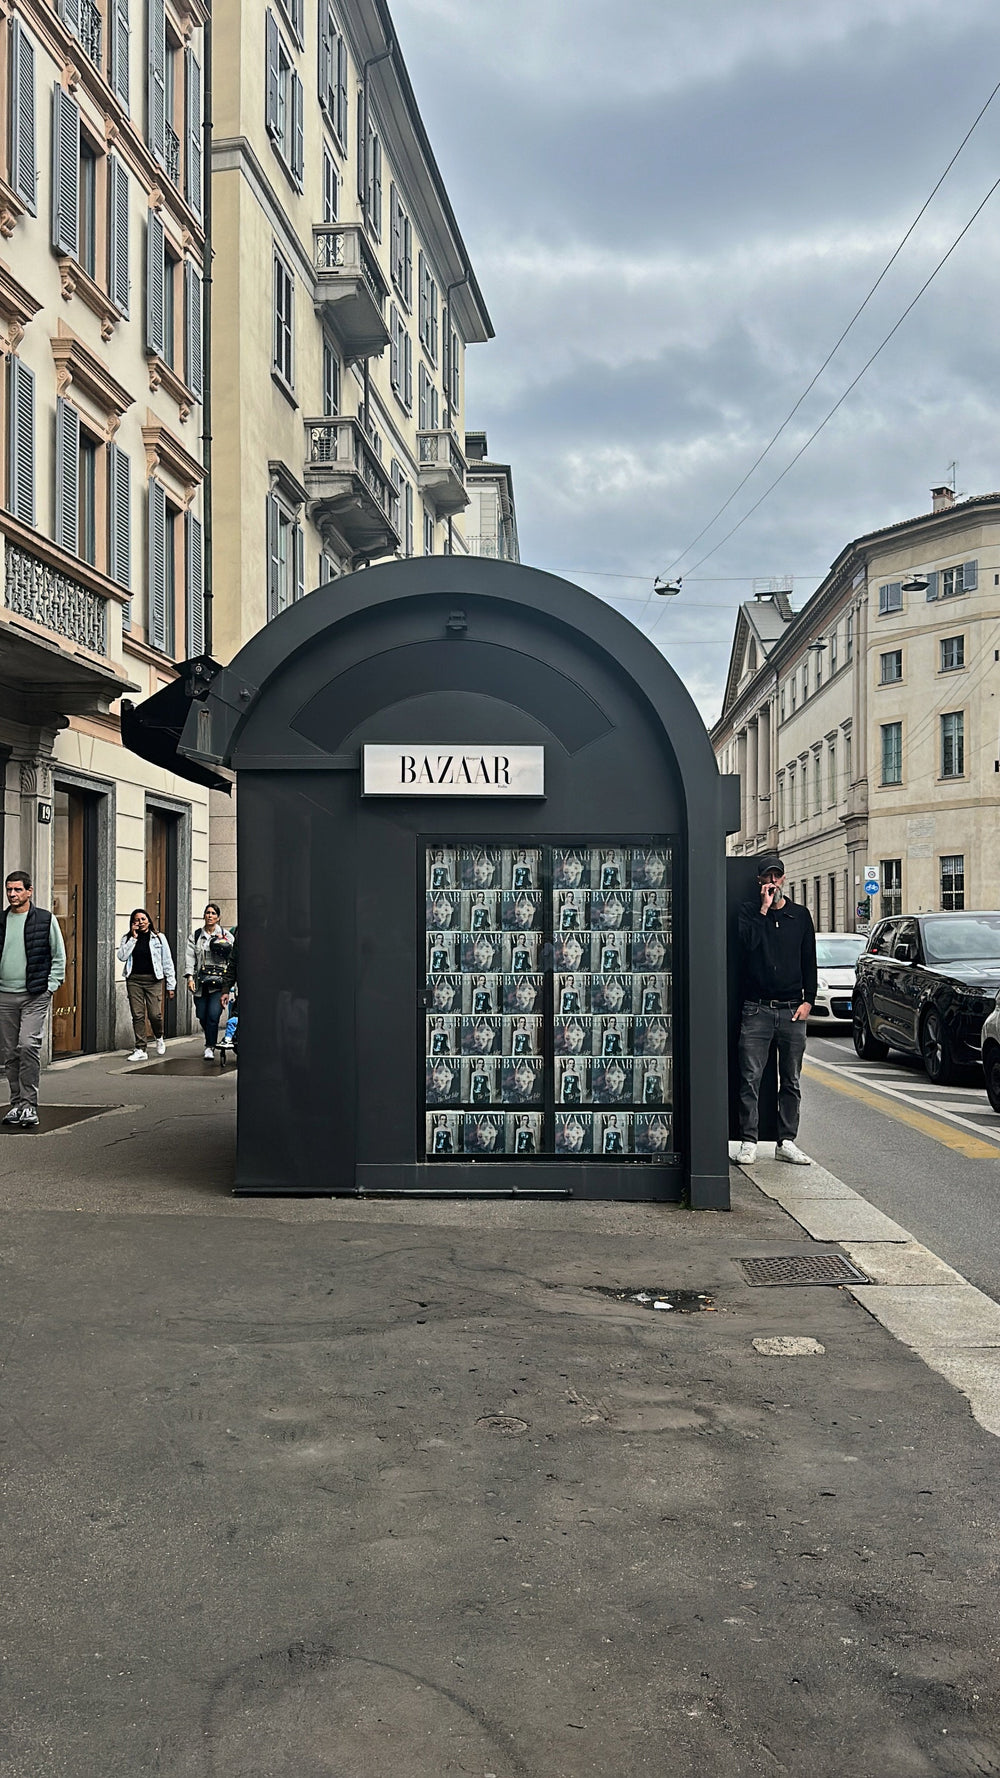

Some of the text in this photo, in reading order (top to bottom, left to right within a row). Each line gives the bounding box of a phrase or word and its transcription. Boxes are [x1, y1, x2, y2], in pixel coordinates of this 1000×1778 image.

[399, 755, 512, 785] BAZAAR
[42, 805, 51, 820] 19
[463, 849, 501, 861] BAZAAR
[503, 891, 542, 902] BAZAAR
[593, 891, 631, 902] BAZAAR
[463, 933, 501, 944] BAZAAR
[505, 975, 543, 986] BAZAAR
[593, 975, 631, 986] BAZAAR
[463, 1017, 501, 1027] BAZAAR
[503, 1058, 542, 1069] BAZAAR
[594, 1058, 632, 1069] BAZAAR
[466, 1114, 504, 1125] BAZAAR
